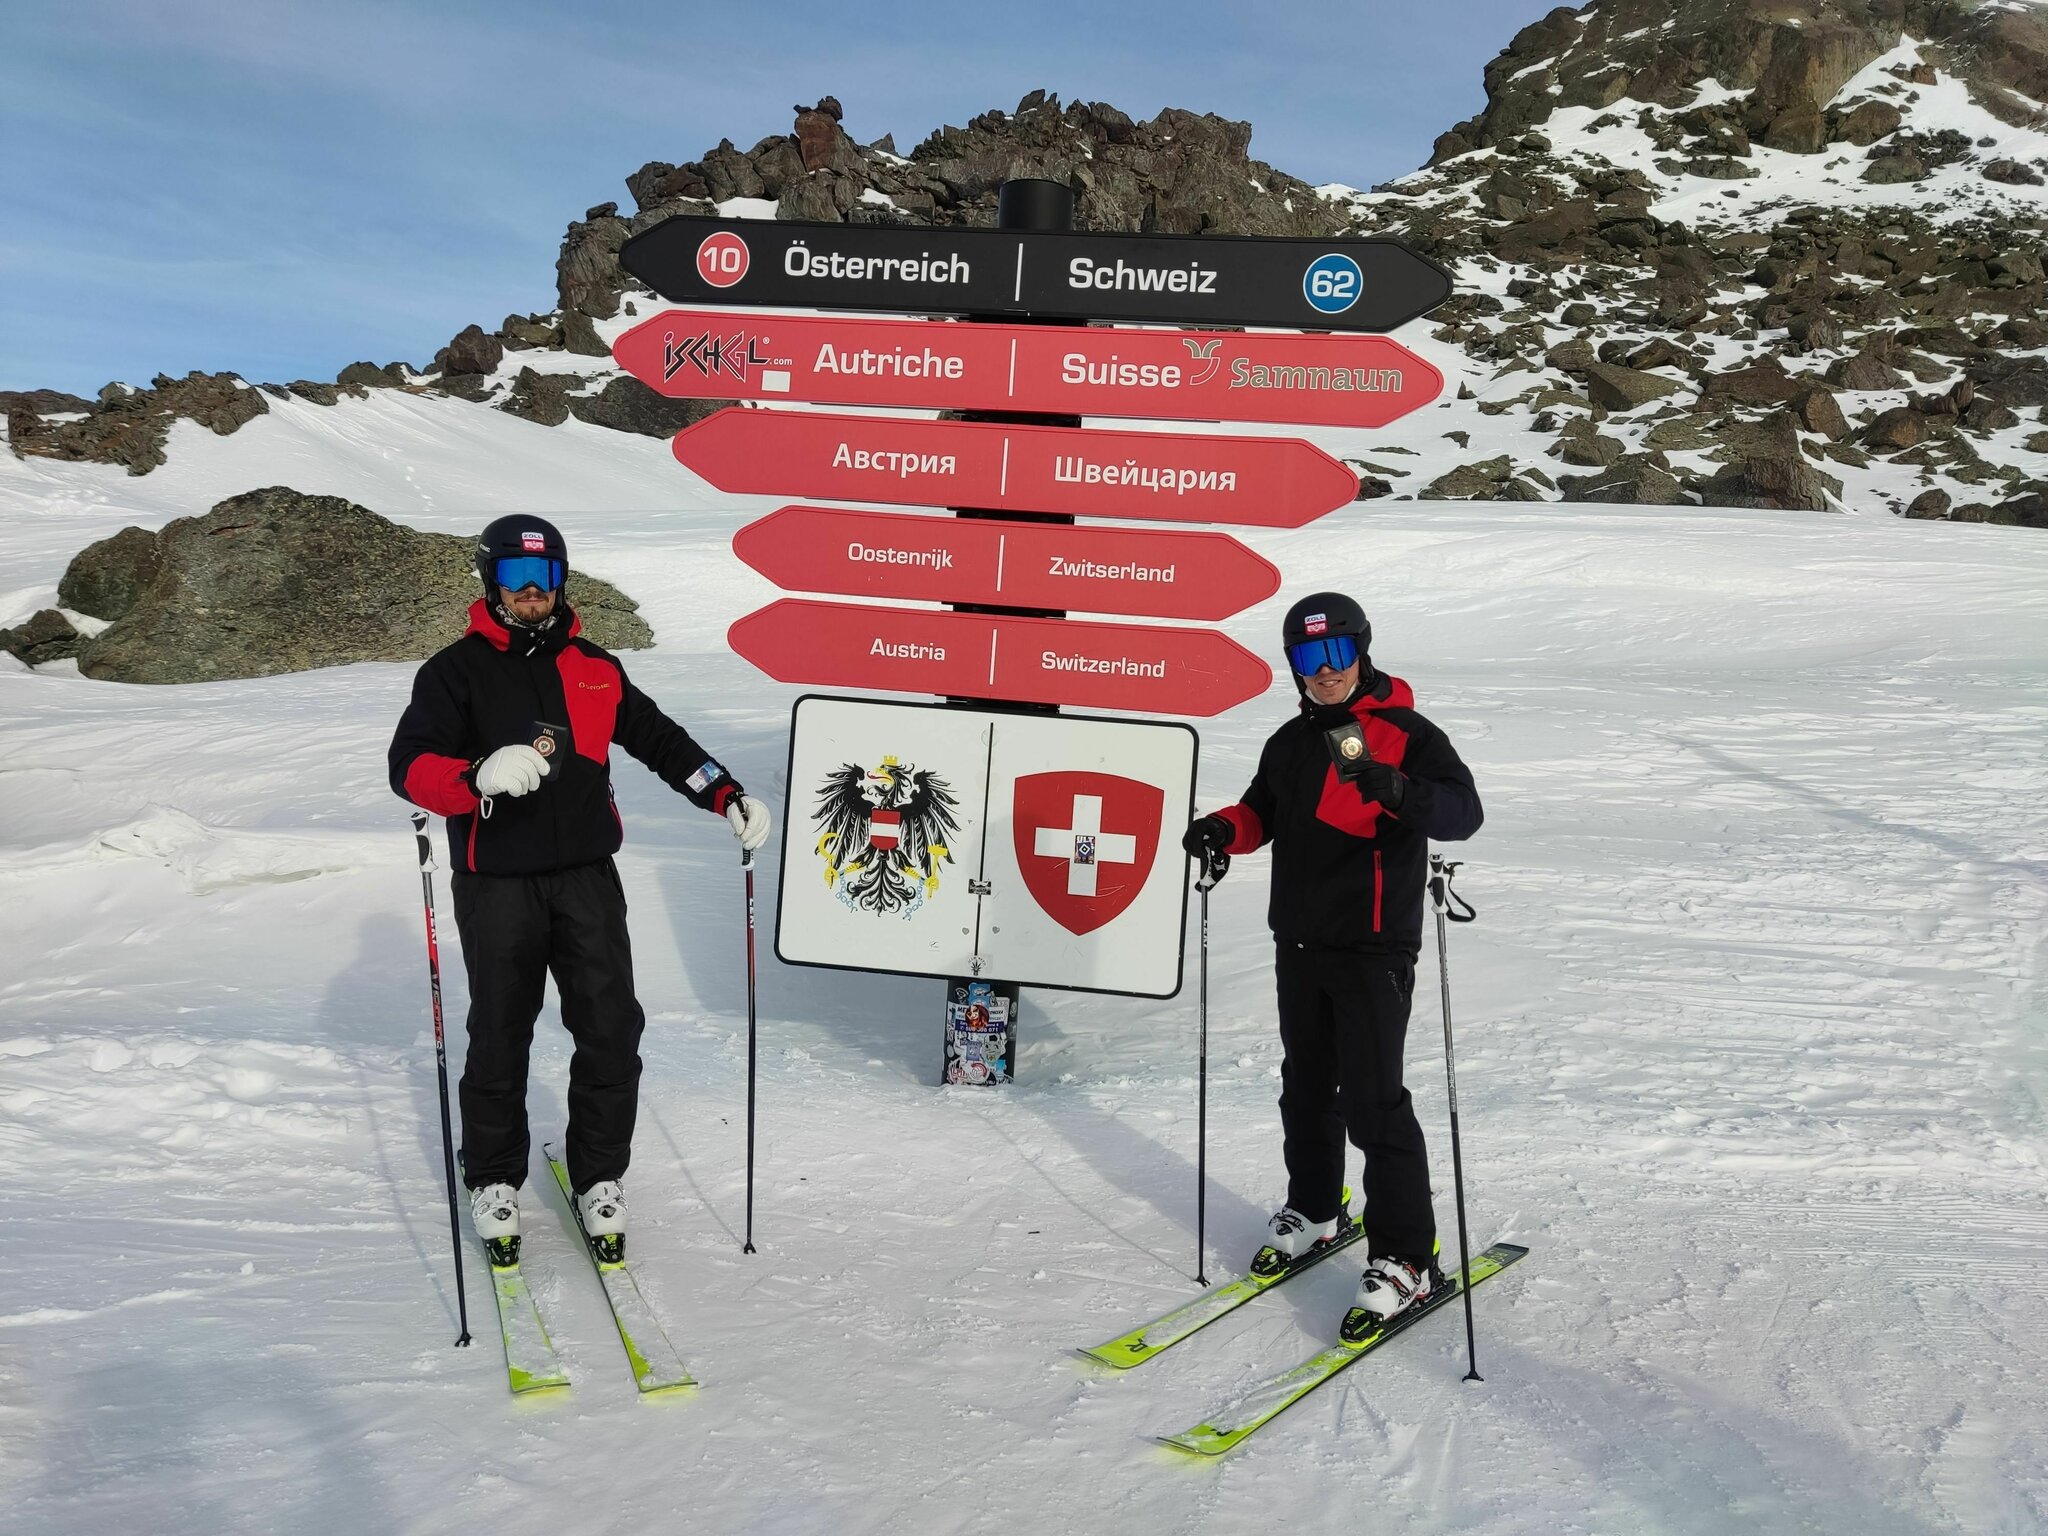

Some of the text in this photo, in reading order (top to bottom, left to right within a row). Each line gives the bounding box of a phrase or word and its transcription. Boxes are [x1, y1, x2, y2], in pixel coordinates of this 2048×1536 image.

[703, 246, 741, 273] 10
[784, 239, 970, 284] Österreich
[1068, 257, 1218, 294] Schweiz
[1311, 269, 1354, 298] 62
[813, 343, 964, 379] Autriche
[1062, 353, 1181, 388] Suisse
[1229, 357, 1403, 393] Samnaun
[832, 442, 956, 479] Австрия
[1054, 455, 1237, 494] Швейцария
[847, 541, 954, 570] Oostenrijk
[1048, 556, 1175, 583] Zwitserland
[1306, 615, 1324, 623] ZOLL
[869, 638, 946, 661] Austria
[1041, 651, 1165, 678] Switzerland
